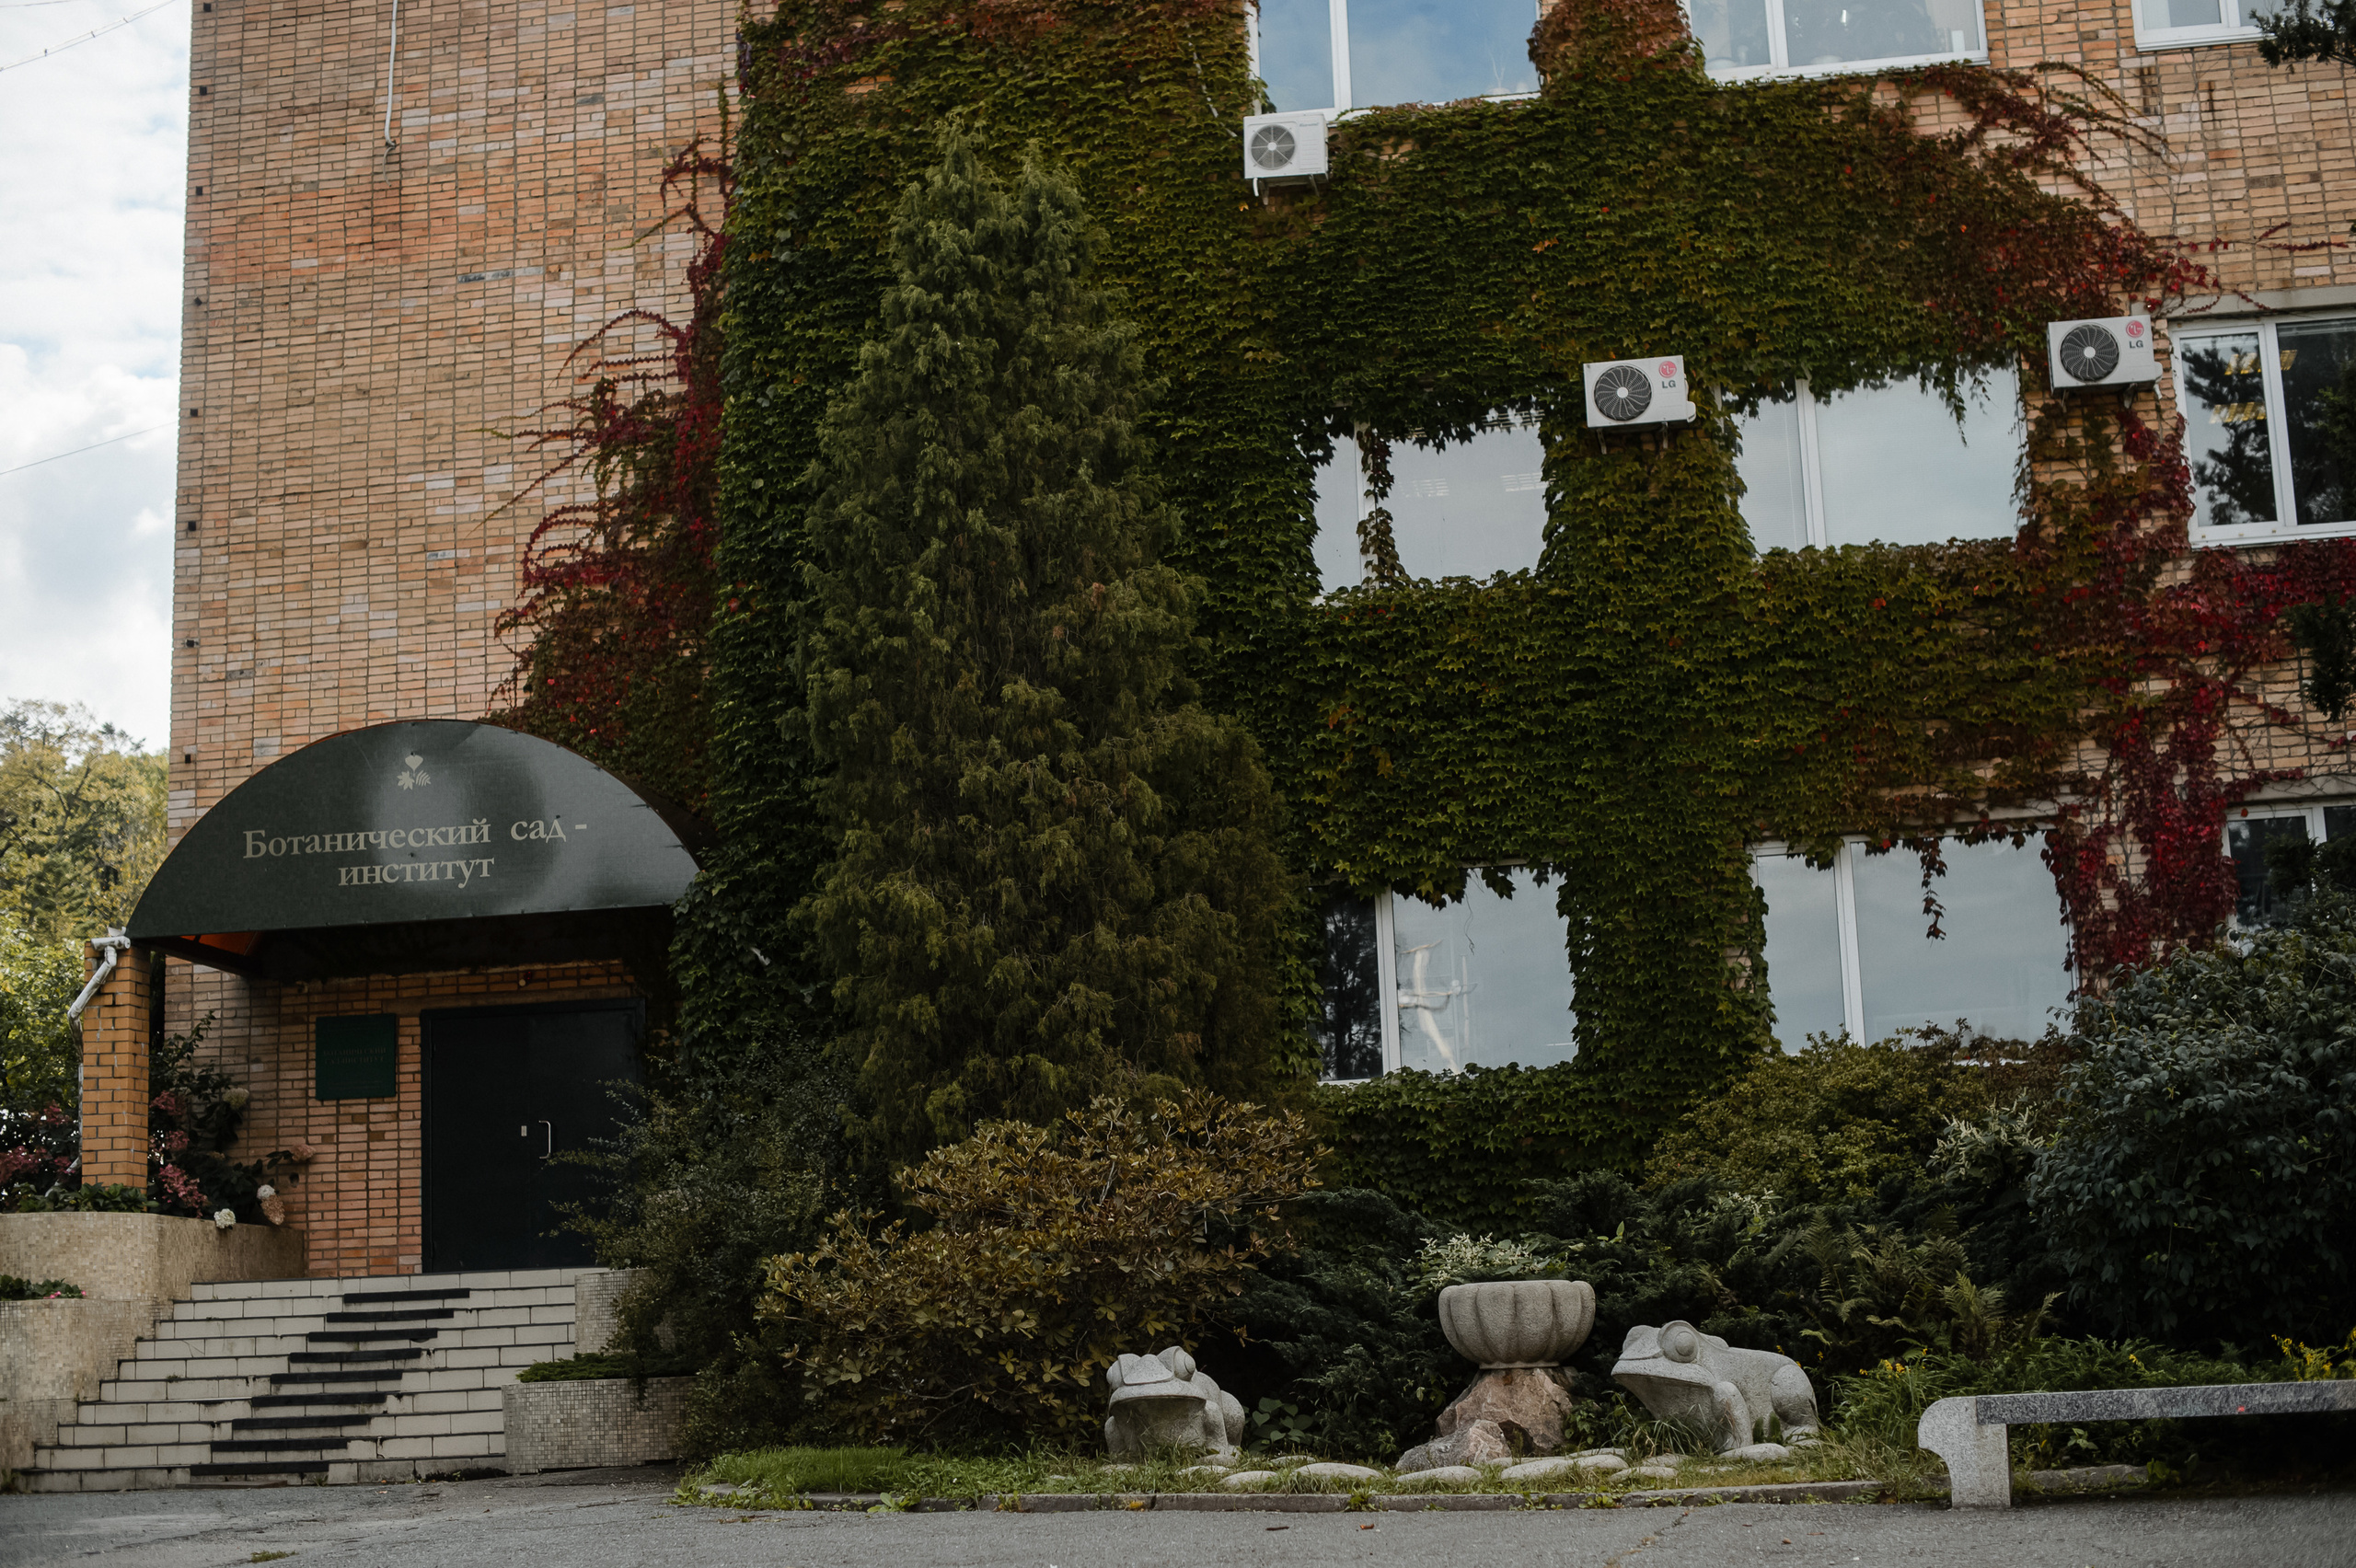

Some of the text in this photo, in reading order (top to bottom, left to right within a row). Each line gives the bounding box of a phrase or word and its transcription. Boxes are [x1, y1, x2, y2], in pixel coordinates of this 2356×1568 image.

[2129, 340, 2144, 349] LG
[1661, 379, 1677, 389] LG
[242, 817, 491, 859] Ботанический
[338, 857, 495, 889] институт
